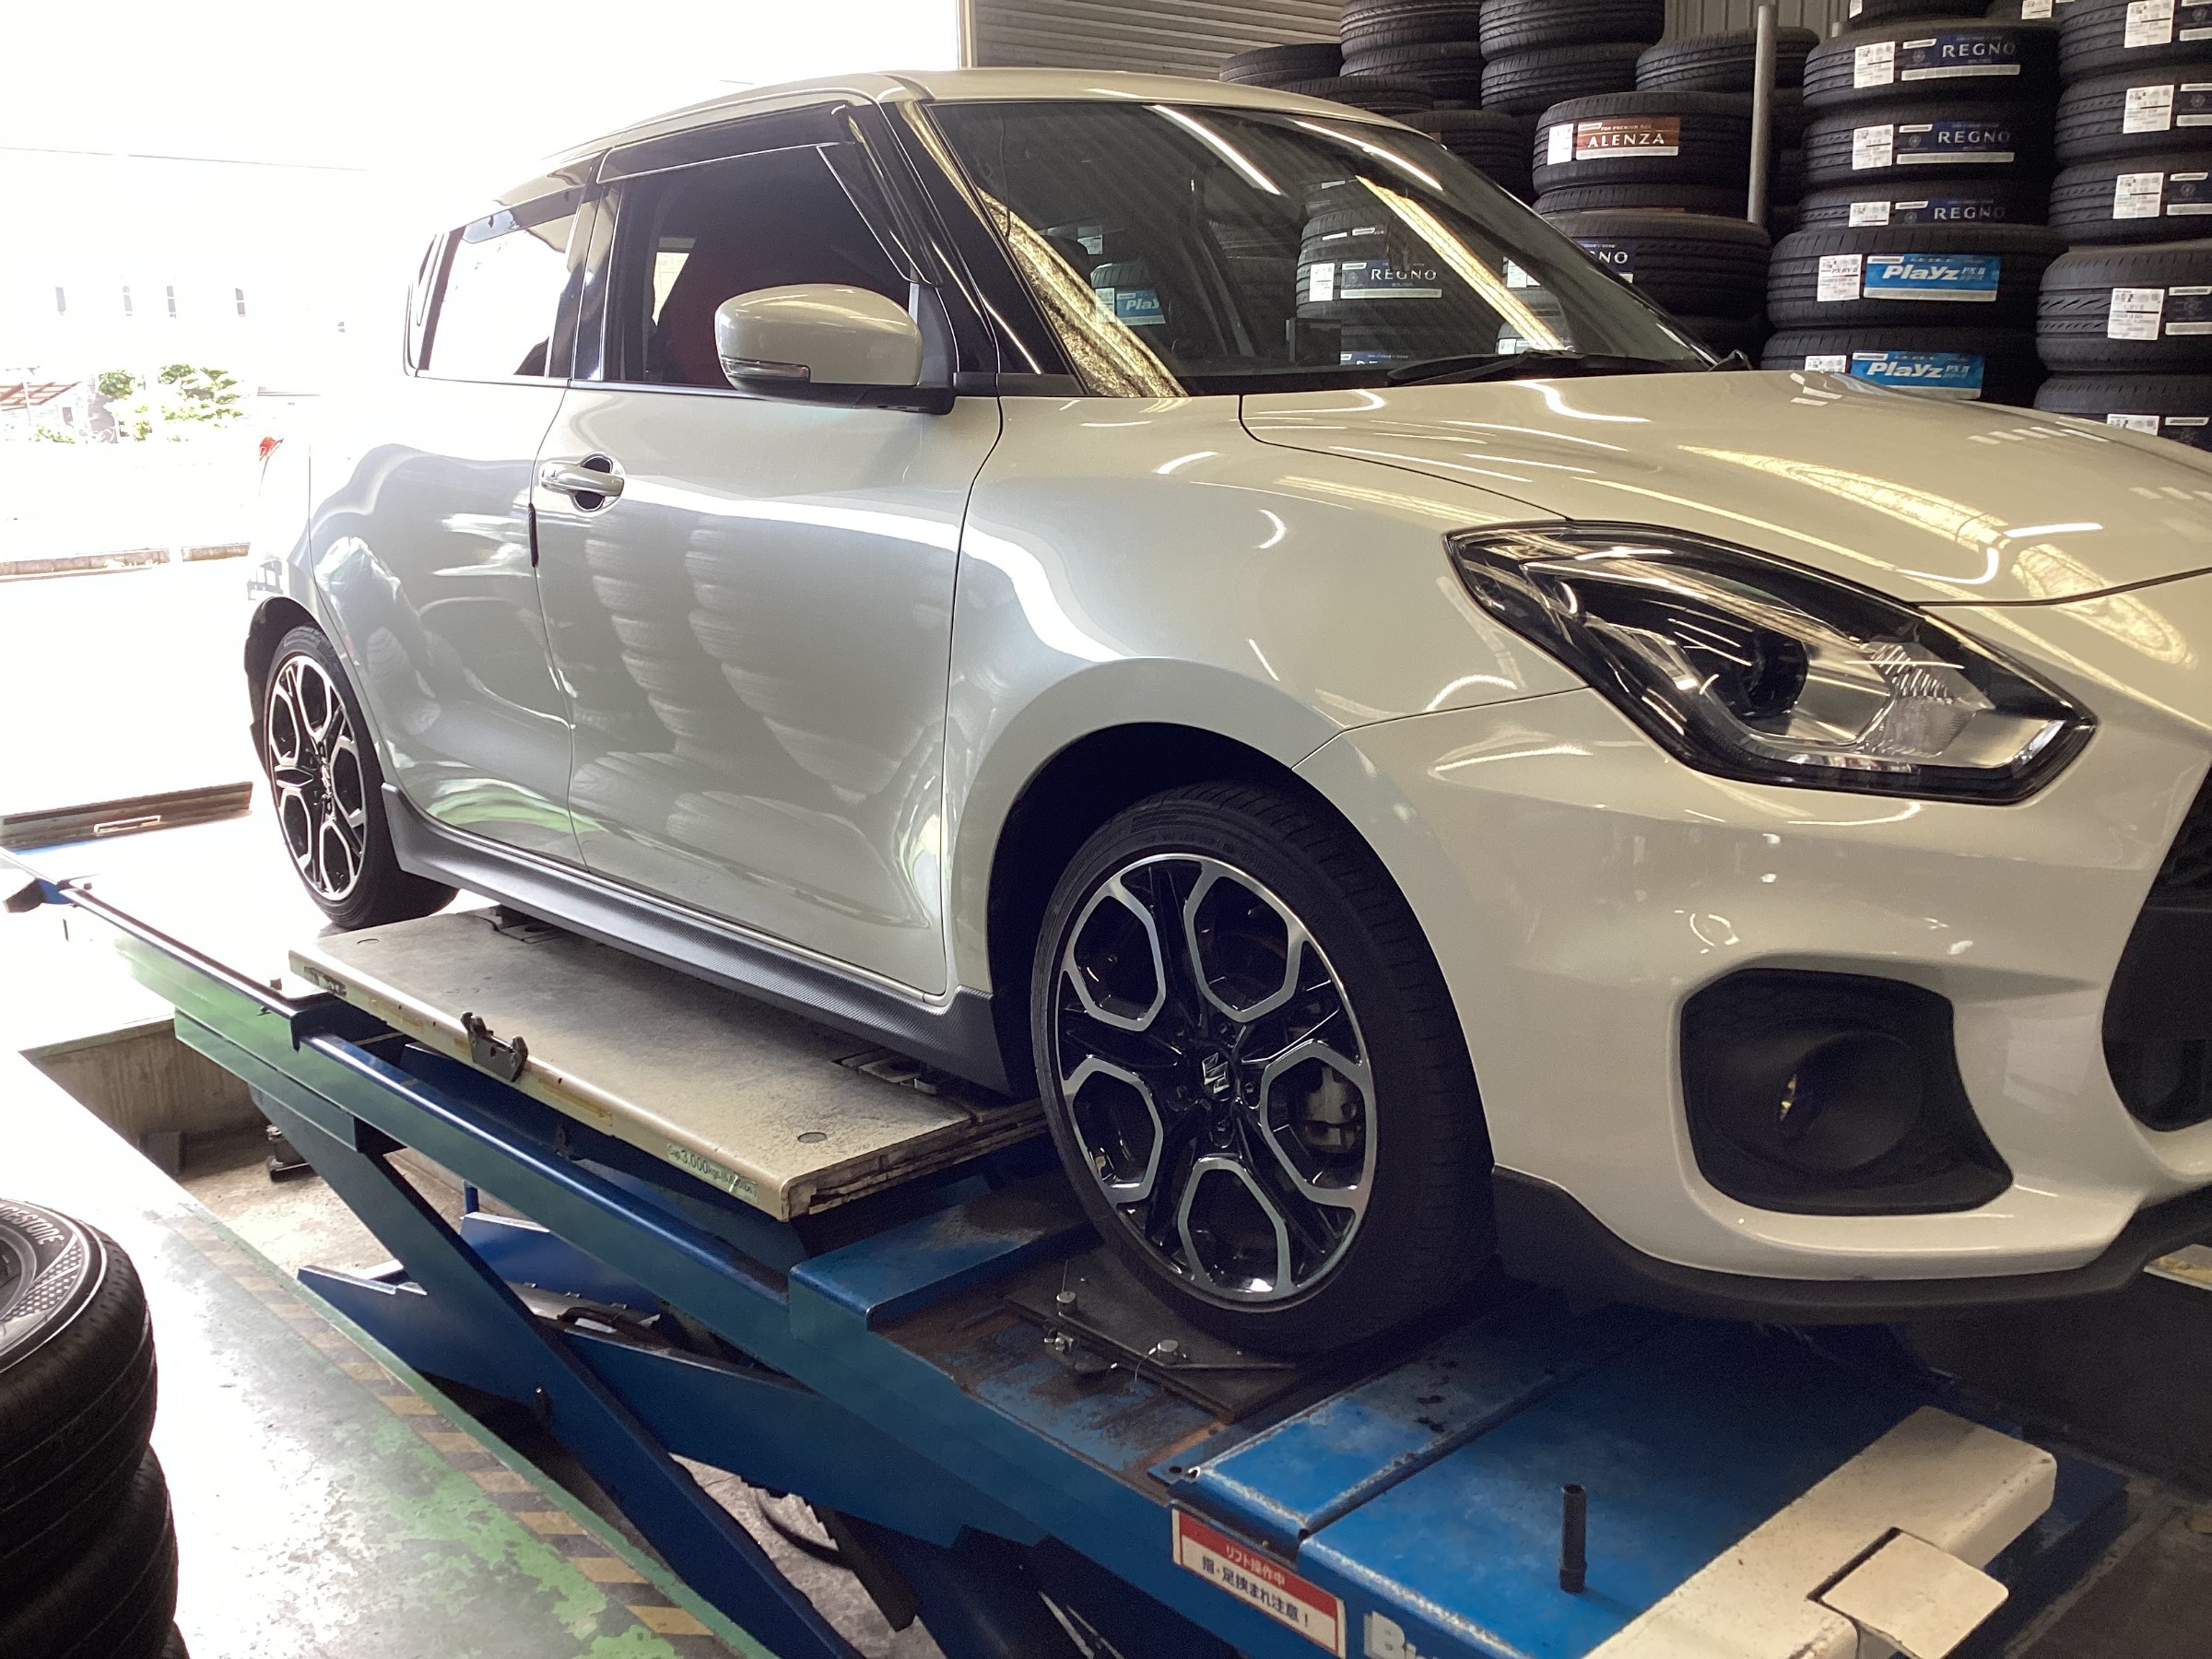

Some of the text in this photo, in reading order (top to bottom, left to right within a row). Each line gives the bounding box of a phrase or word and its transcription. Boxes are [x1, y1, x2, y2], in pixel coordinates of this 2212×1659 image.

[1942, 42, 2016, 58] REGNO
[1587, 133, 1665, 148] ALENZA
[1937, 131, 2010, 144] REGNO
[1934, 206, 2006, 220] REGNO
[1589, 250, 1629, 265] NO
[1371, 268, 1437, 281] REGNO
[1882, 264, 1960, 281] Playz
[1866, 361, 1945, 379] Playz
[0, 1204, 65, 1245] GESTONE
[1226, 1544, 1286, 1586] リフト操作中
